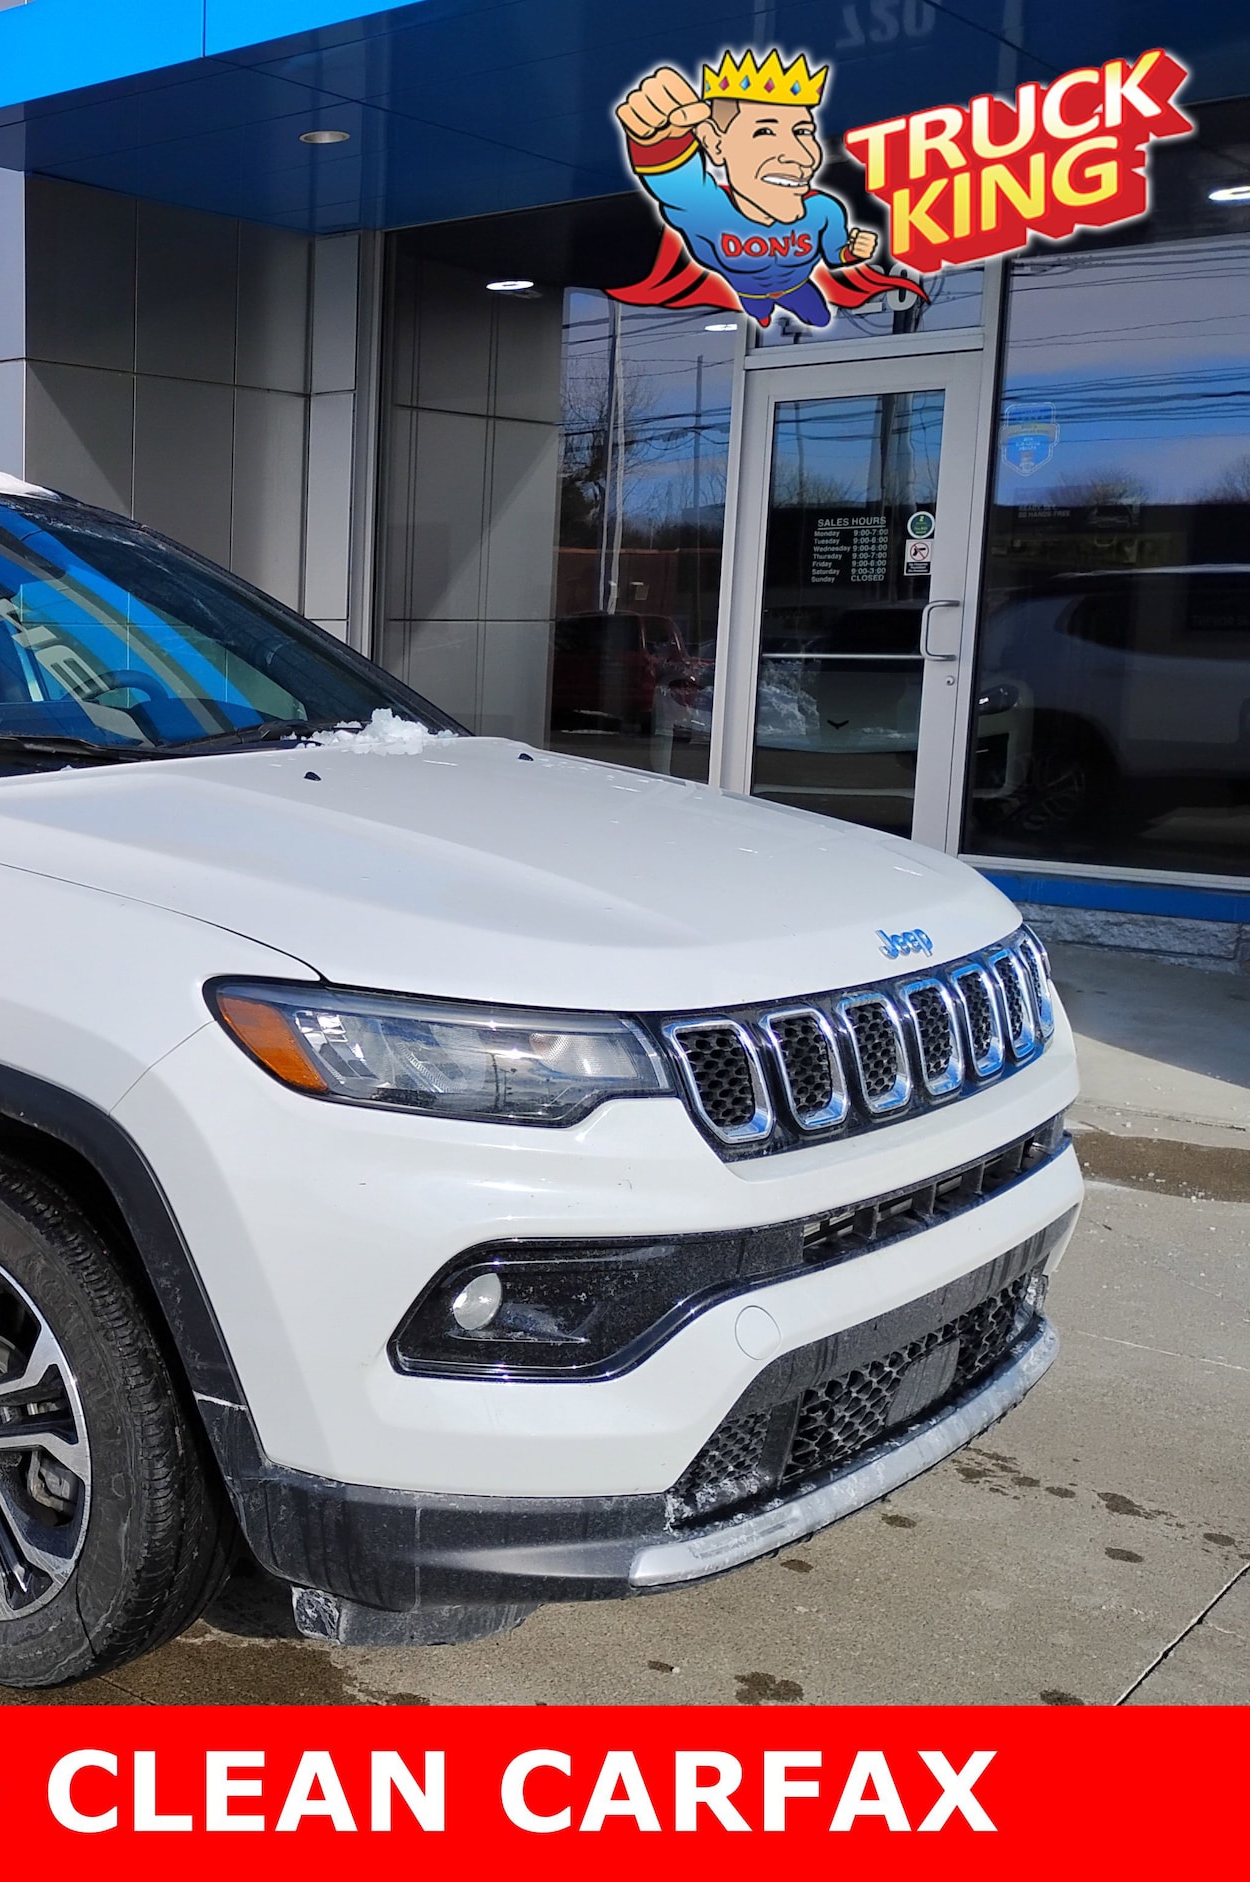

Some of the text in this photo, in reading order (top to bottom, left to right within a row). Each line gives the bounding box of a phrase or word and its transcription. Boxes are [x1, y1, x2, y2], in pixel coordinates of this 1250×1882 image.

[817, 516, 886, 527] SALES HOURS
[814, 530, 840, 538] Monday
[812, 560, 832, 568] Friday
[812, 568, 840, 576] Saturday
[850, 574, 884, 582] CLOSED
[875, 928, 933, 960] Jeep
